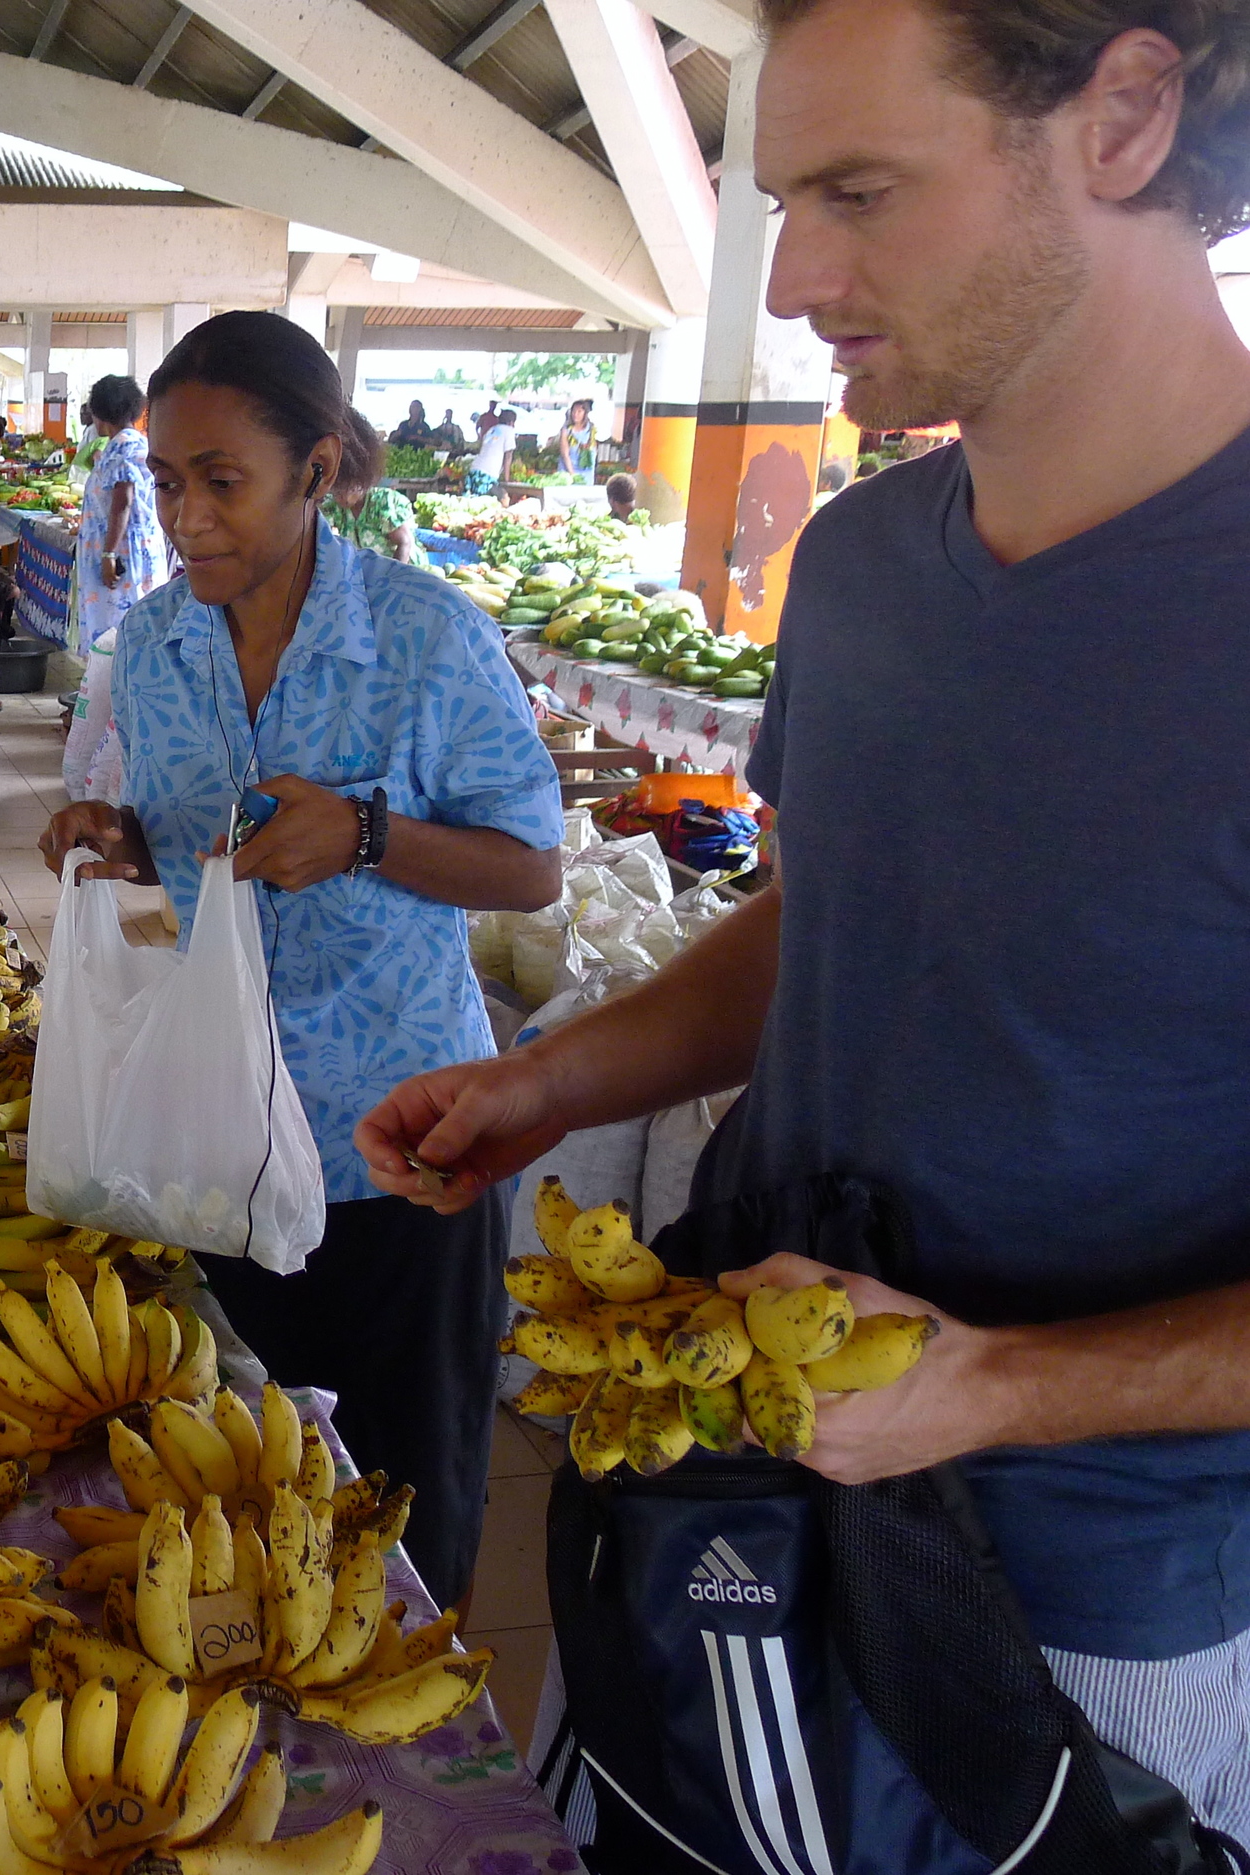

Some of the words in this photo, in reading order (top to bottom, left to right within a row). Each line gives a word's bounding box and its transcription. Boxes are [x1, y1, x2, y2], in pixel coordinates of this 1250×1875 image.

[688, 1578, 777, 1604] adidas
[200, 1621, 257, 1659] 200
[84, 1796, 144, 1839] 150
